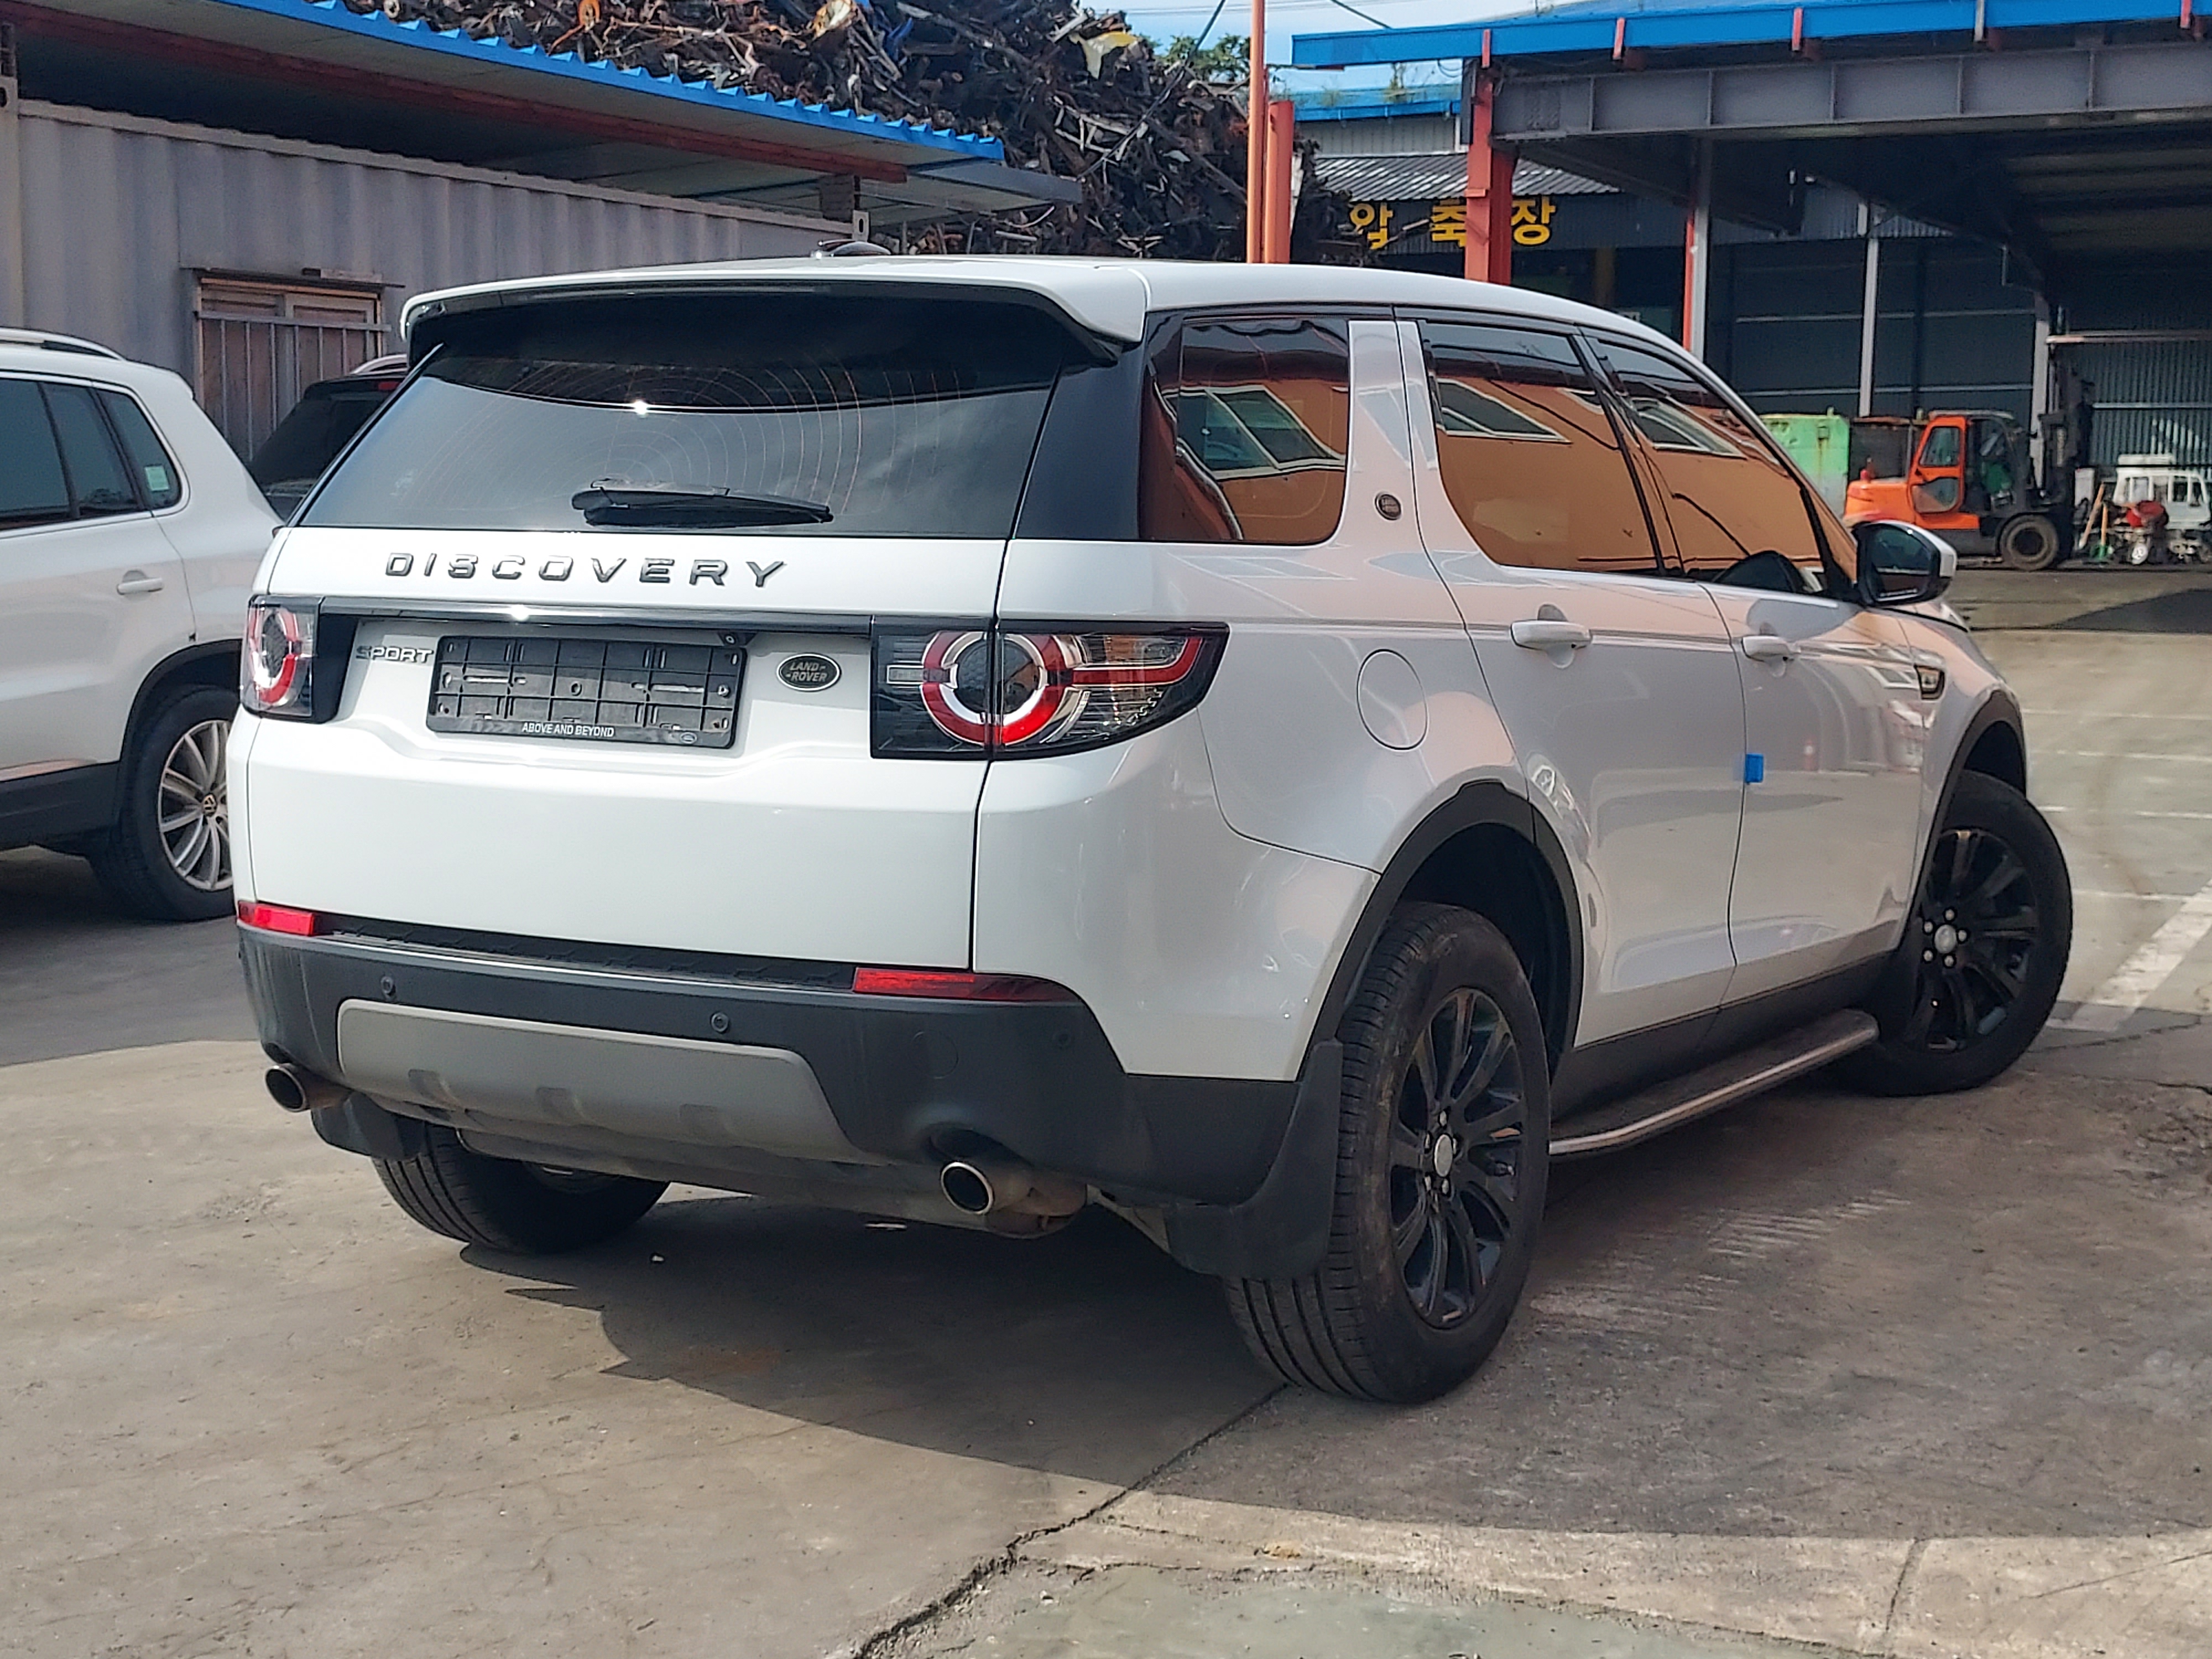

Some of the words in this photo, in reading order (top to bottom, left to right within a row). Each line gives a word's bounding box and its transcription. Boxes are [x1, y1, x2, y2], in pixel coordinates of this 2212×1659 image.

[385, 552, 786, 588] DISCOVERY
[356, 645, 434, 663] SPORT
[521, 722, 553, 734] ABOVE
[554, 724, 574, 735] AND
[575, 726, 614, 737] BEYOND
